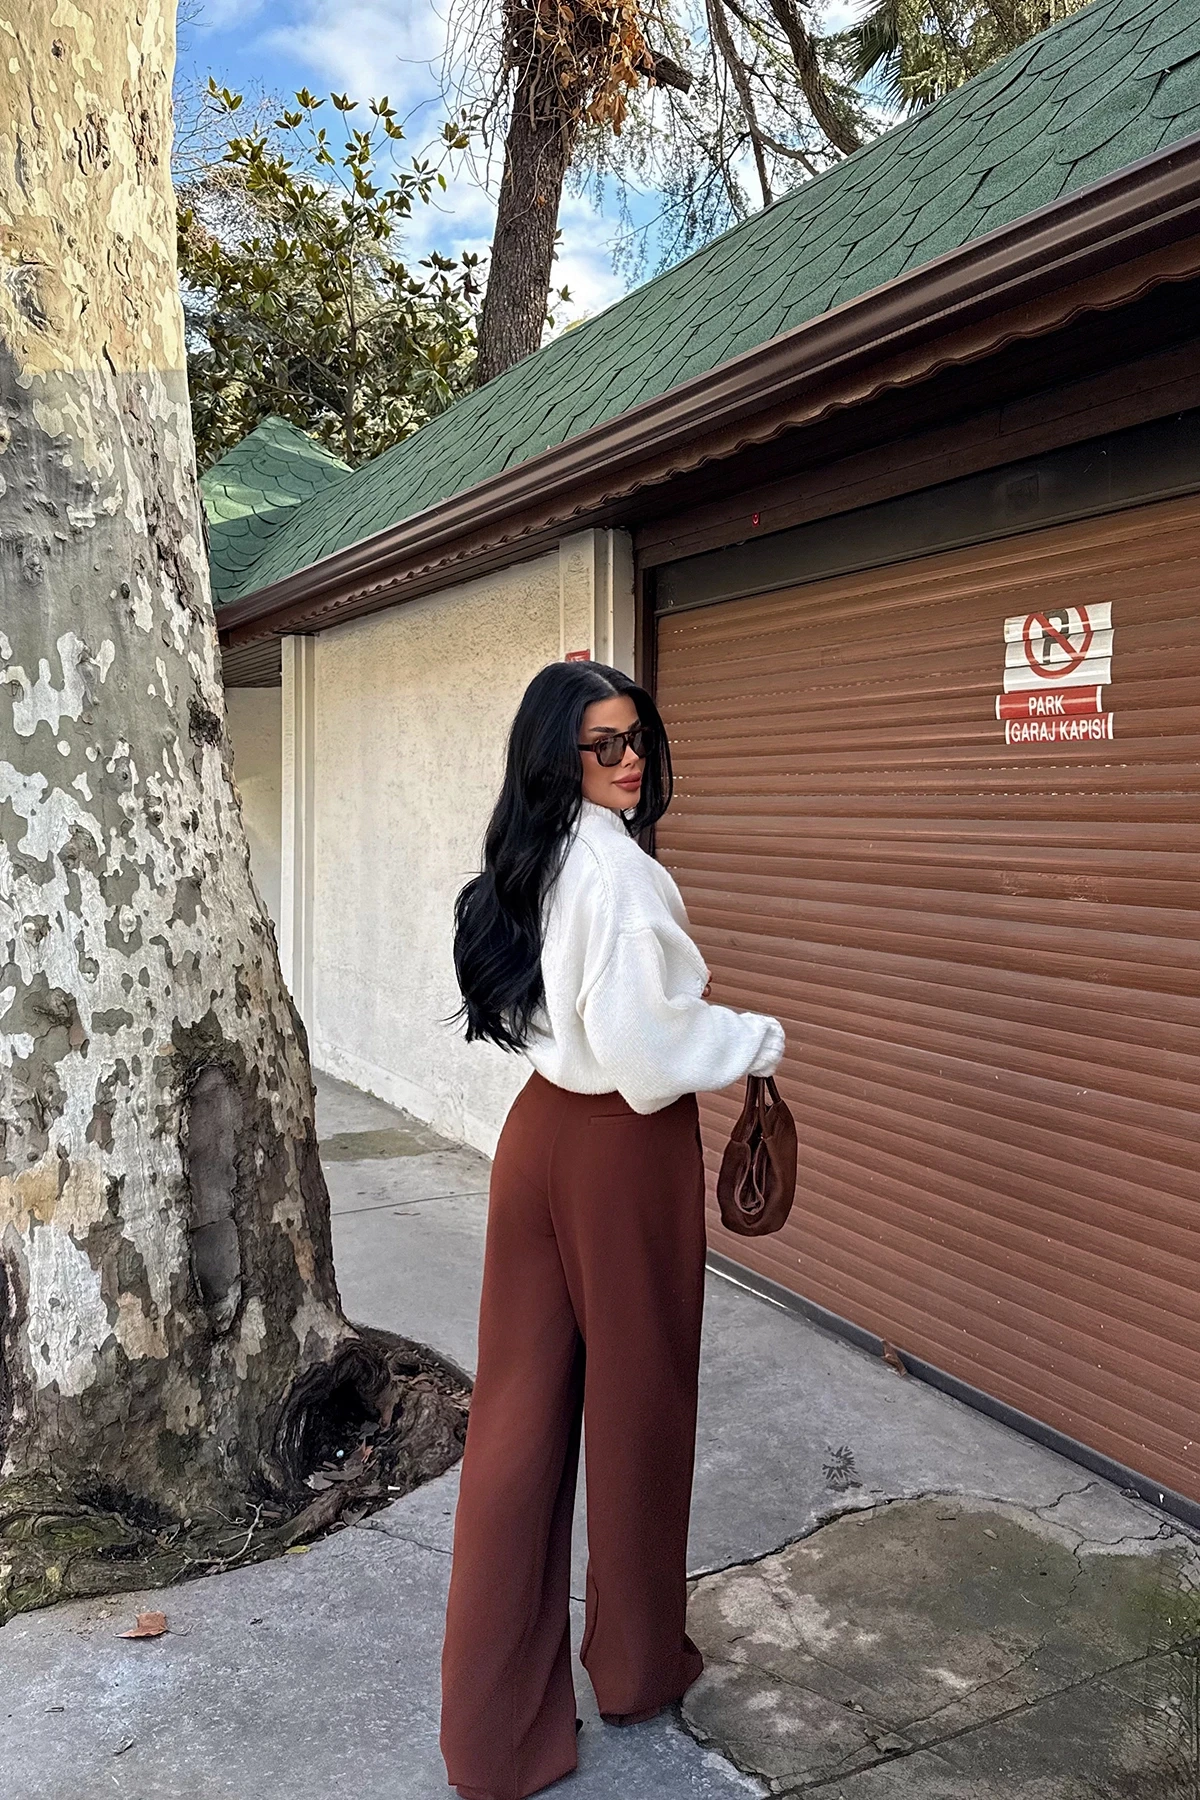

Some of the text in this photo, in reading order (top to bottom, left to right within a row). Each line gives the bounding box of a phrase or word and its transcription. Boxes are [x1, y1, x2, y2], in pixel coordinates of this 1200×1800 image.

[1028, 694, 1065, 716] PARK
[1011, 718, 1106, 742] GARAJ KAPISI
